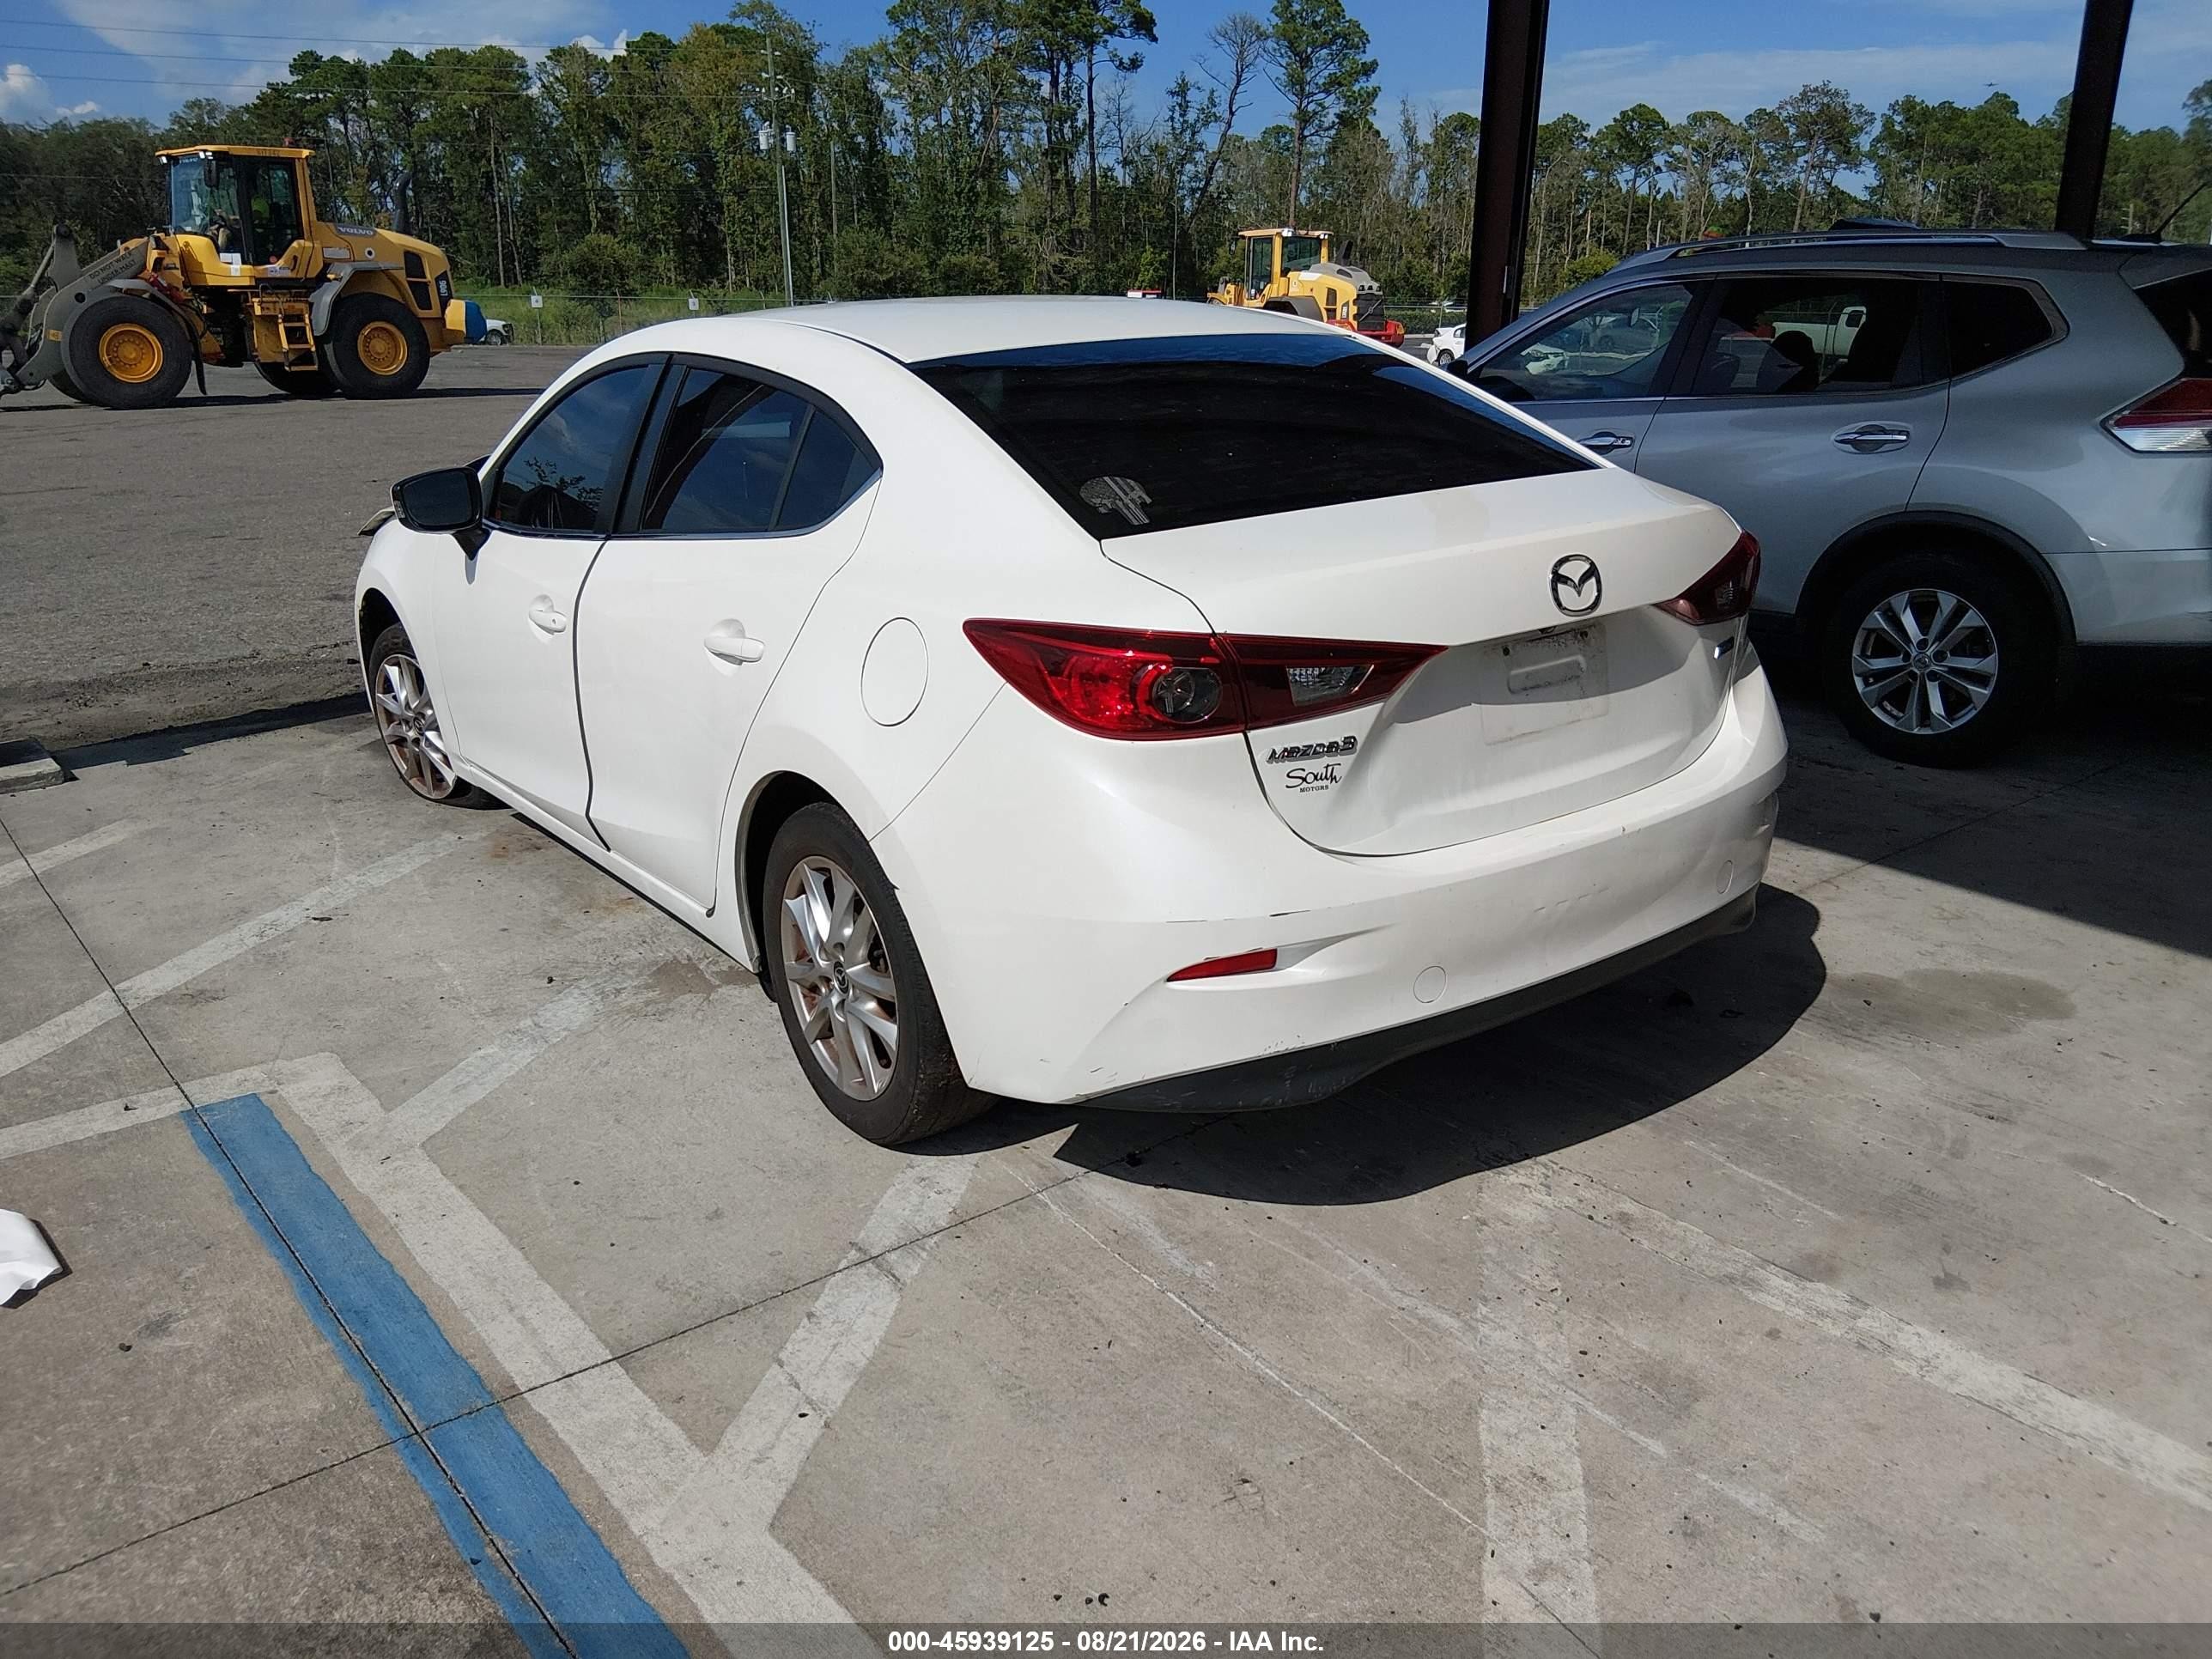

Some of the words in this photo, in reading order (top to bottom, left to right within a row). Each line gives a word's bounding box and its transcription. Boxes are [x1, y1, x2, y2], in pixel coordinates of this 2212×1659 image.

[337, 226, 374, 235] VOLVO
[1285, 763, 1342, 789] South
[1299, 784, 1329, 793] MOTORS
